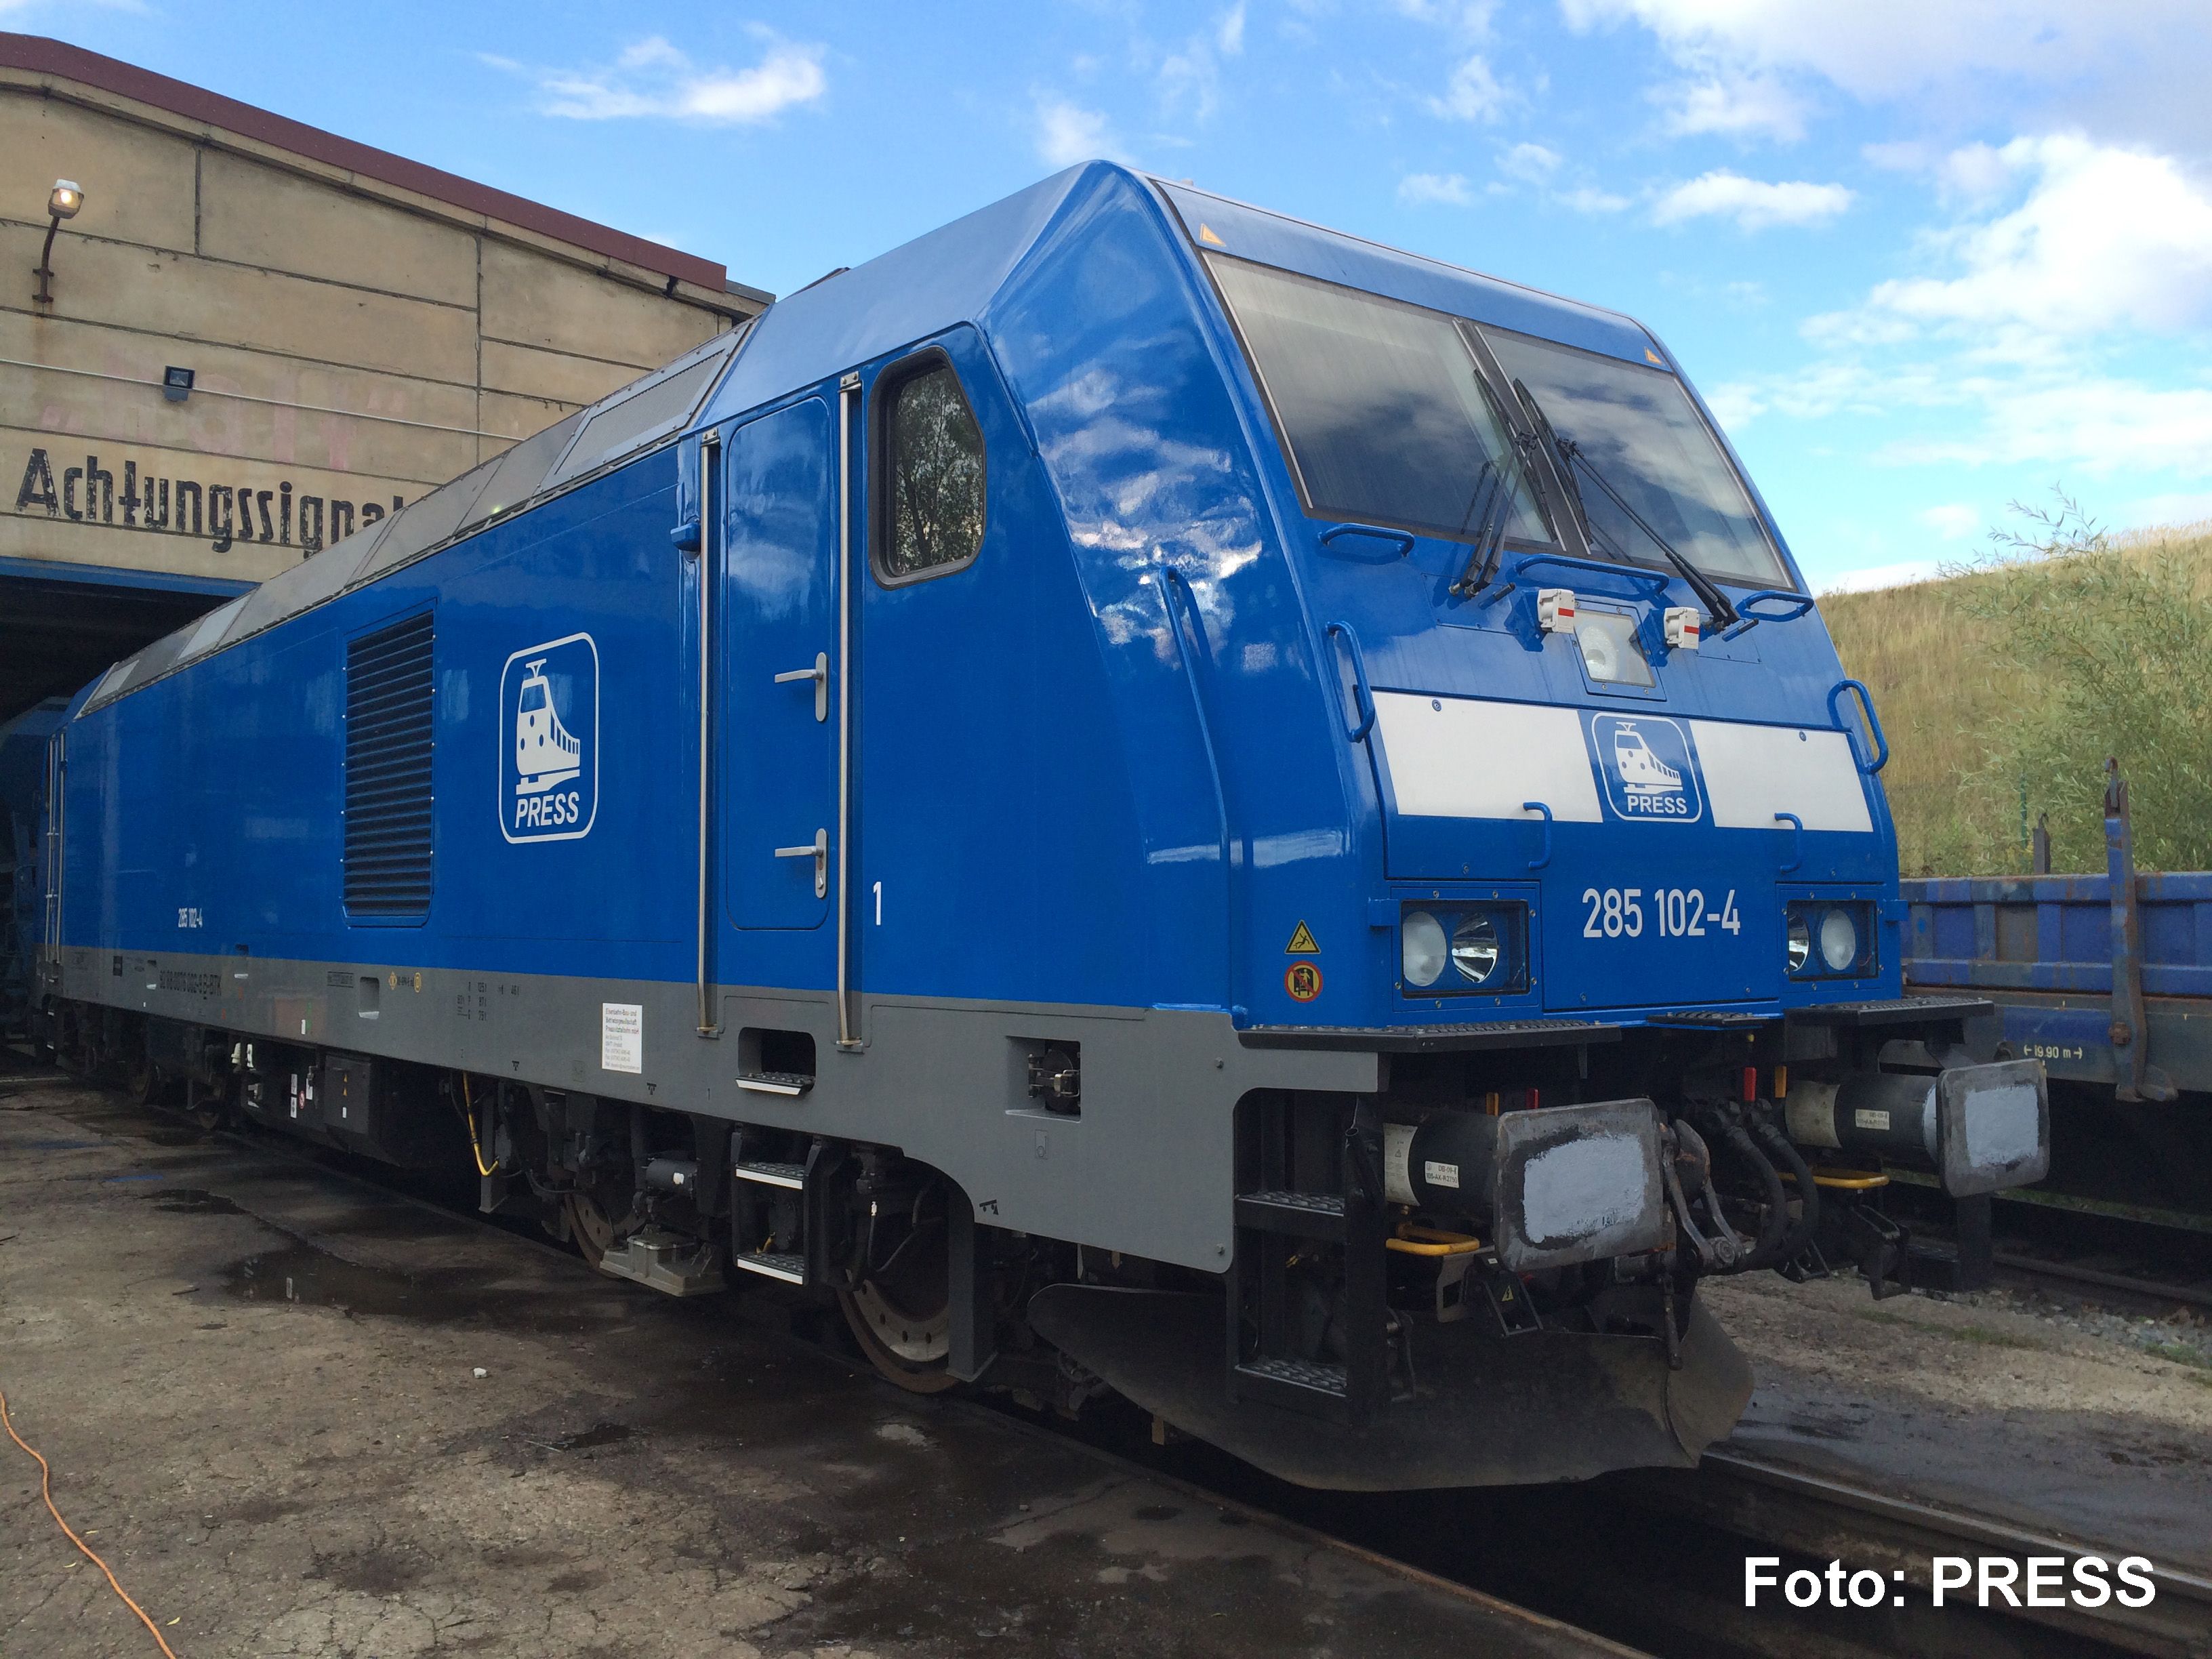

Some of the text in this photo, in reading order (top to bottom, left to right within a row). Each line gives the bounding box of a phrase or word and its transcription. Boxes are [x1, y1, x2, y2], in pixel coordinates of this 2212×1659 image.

[14, 447, 404, 560] Achtungssign
[515, 792, 579, 828] PRESS
[1627, 795, 1687, 815] PRESS
[873, 881, 882, 926] 1
[1582, 888, 1741, 938] 285 102-4
